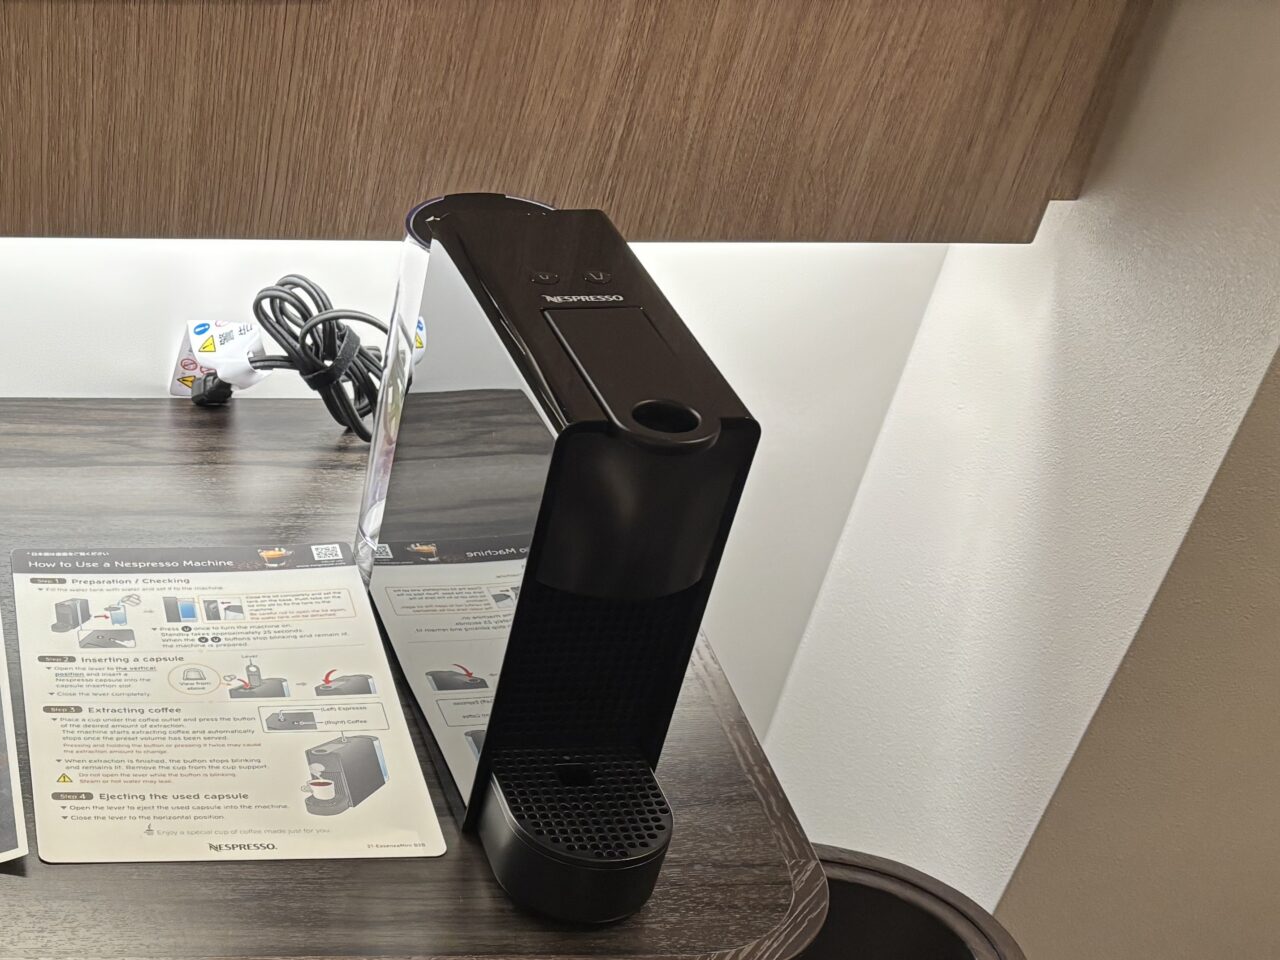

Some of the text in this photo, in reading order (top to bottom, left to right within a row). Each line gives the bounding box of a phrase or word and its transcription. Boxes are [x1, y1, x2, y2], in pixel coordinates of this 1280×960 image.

[541, 294, 624, 303] NESPRESSO
[29, 560, 56, 568] How
[60, 560, 72, 568] to
[76, 560, 100, 568] Use
[115, 560, 179, 570] Nespresso
[183, 558, 234, 568] Machine
[71, 577, 190, 586] Preparation Checking
[99, 793, 146, 801] Ejecting
[204, 793, 249, 801] capsule
